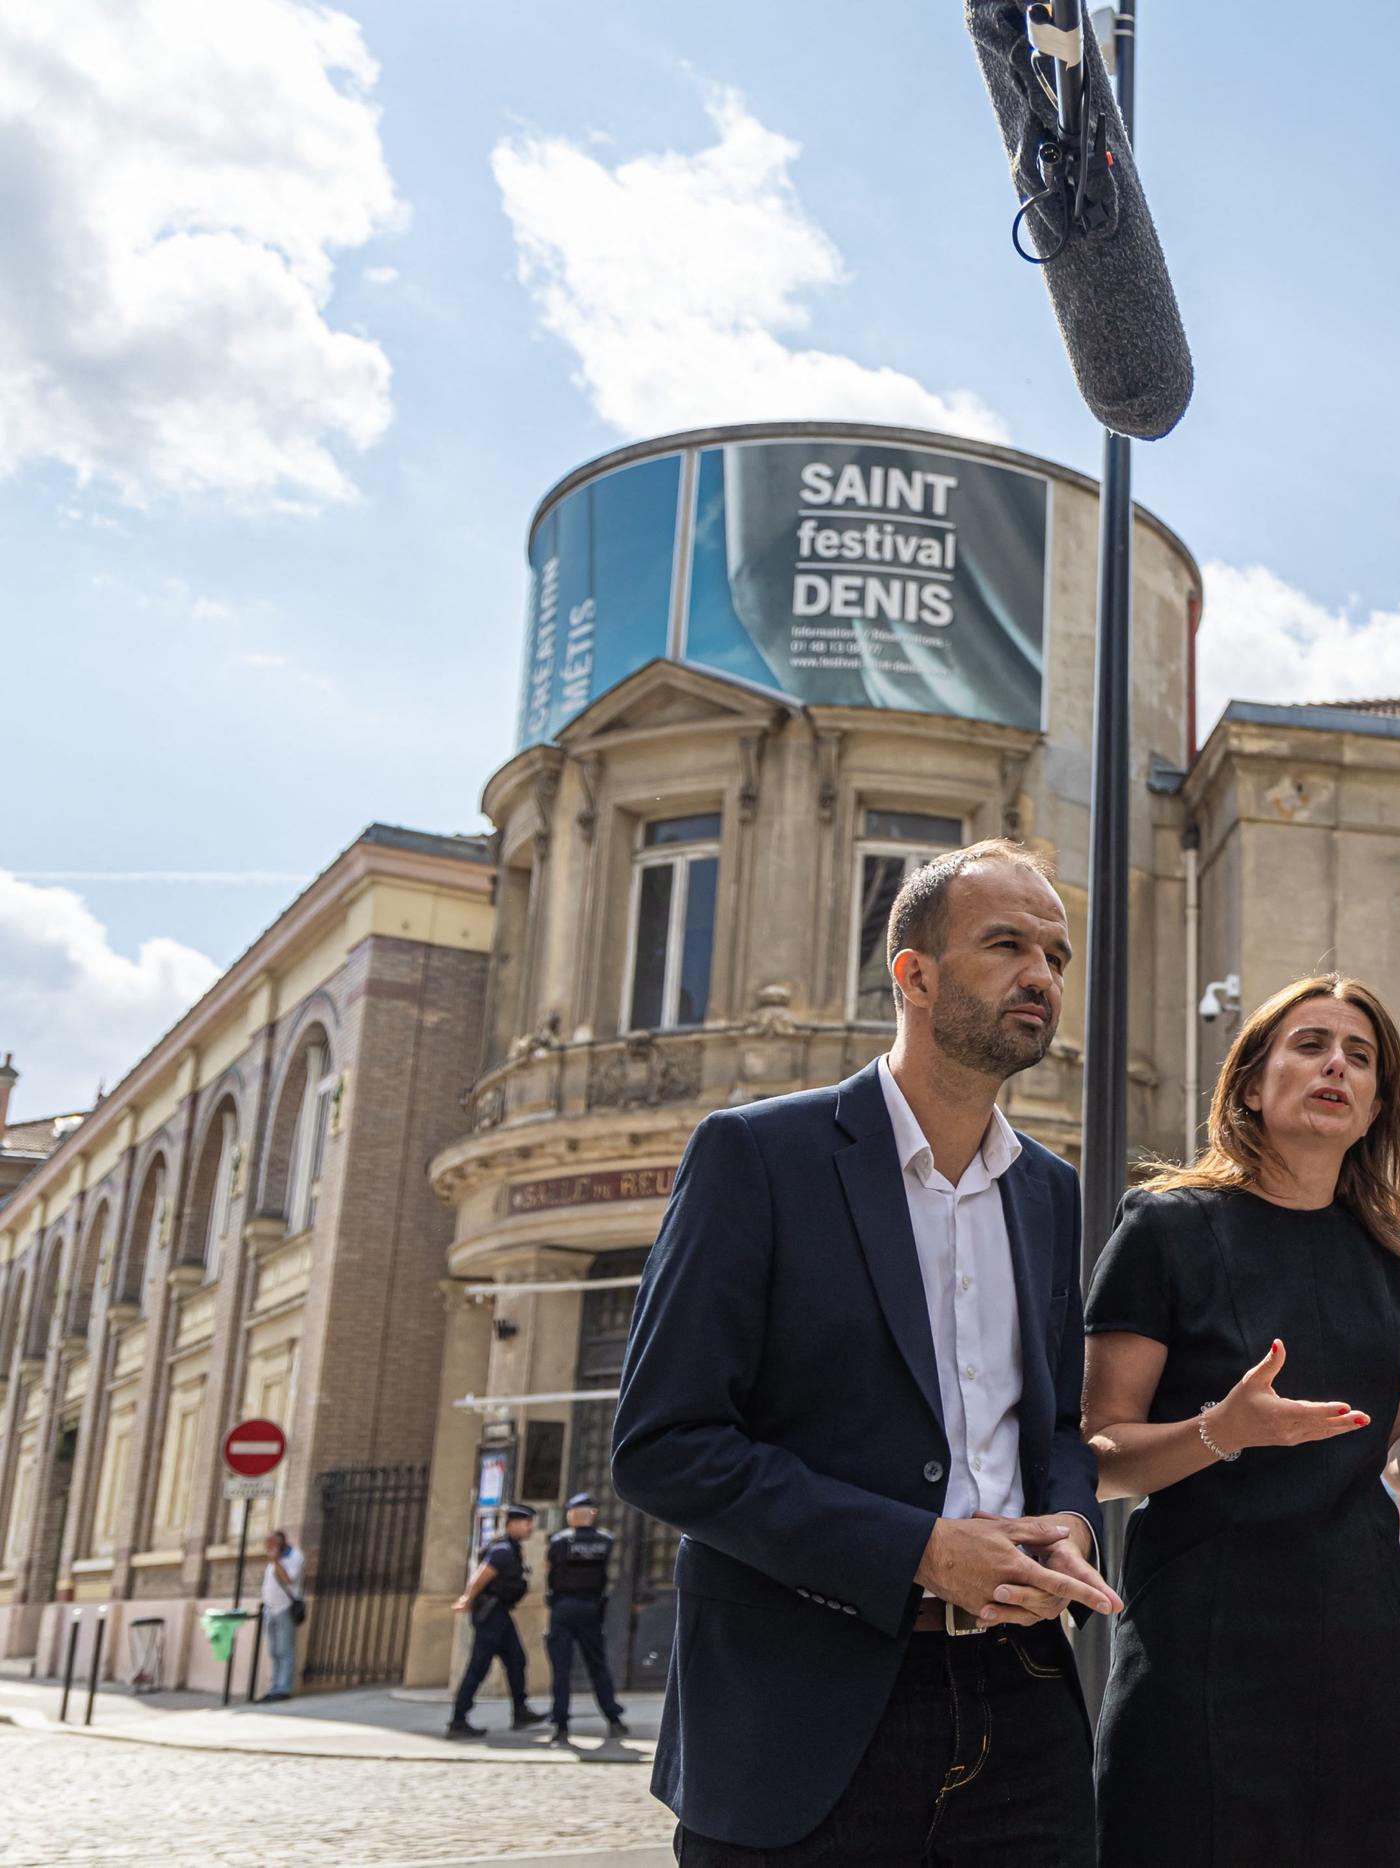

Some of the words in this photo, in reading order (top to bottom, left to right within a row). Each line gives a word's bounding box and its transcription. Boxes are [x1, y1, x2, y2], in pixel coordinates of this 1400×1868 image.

[800, 462, 958, 516] SAINT
[797, 519, 957, 570] festival
[792, 573, 955, 628] DENIS
[560, 597, 597, 714] MÉTIS
[620, 1170, 675, 1196] REU
